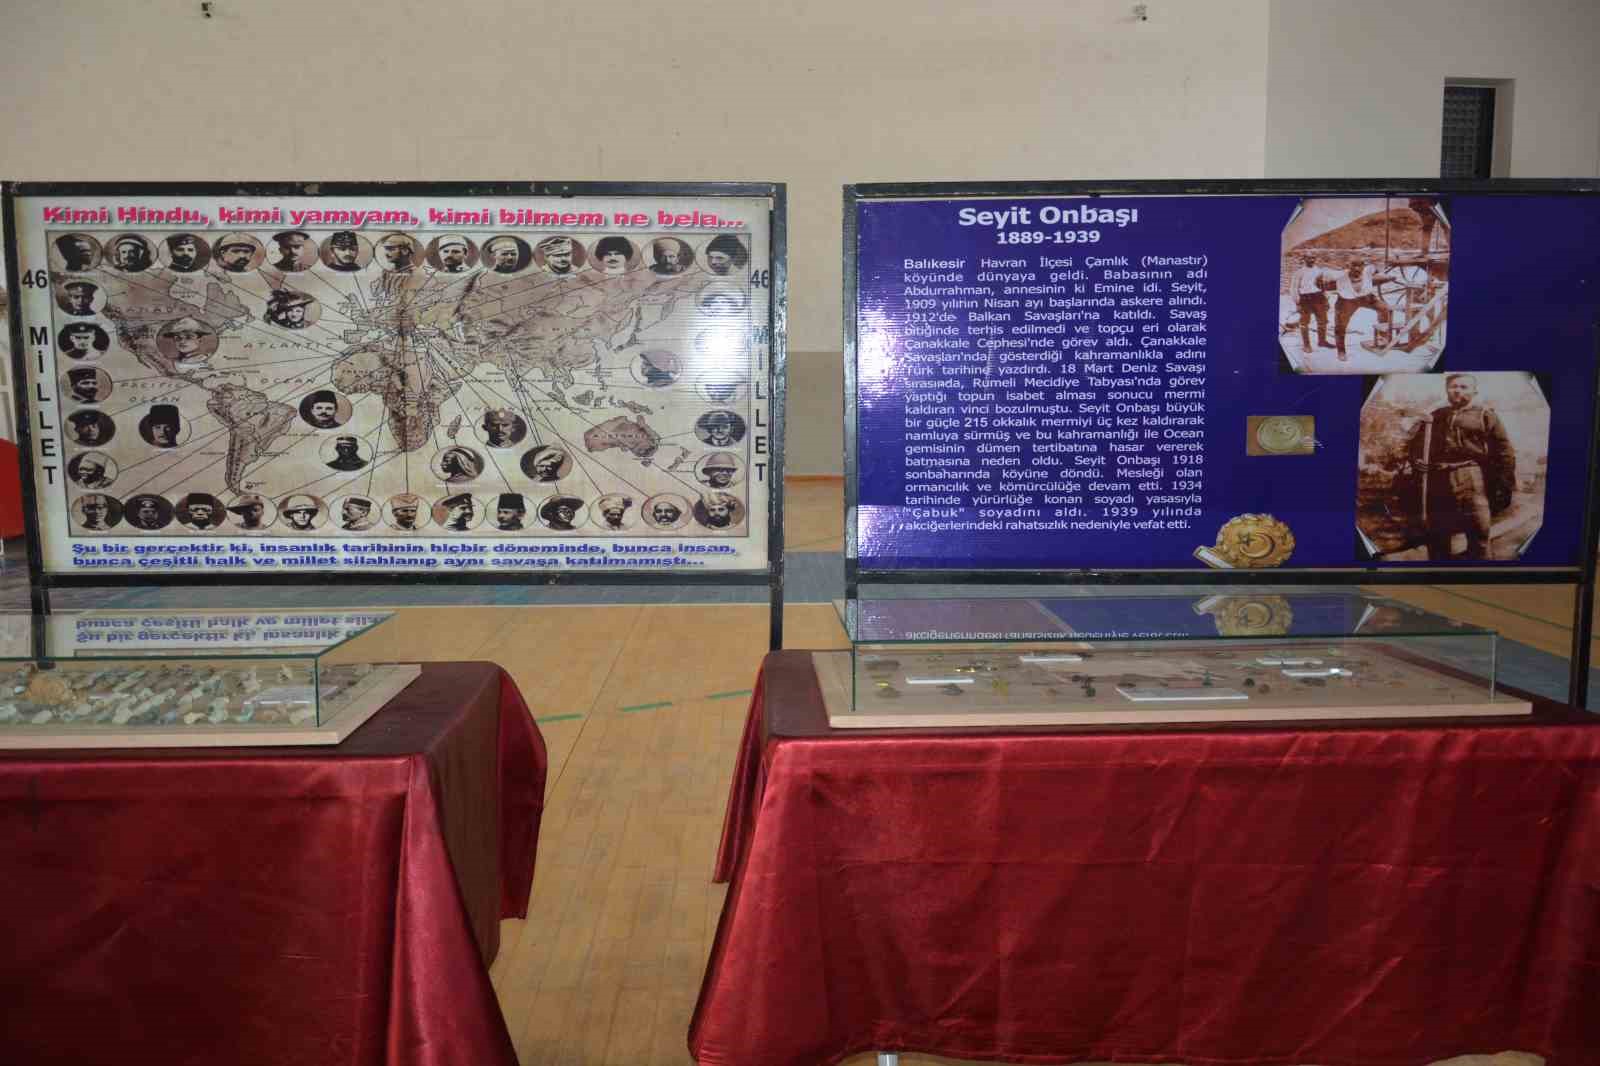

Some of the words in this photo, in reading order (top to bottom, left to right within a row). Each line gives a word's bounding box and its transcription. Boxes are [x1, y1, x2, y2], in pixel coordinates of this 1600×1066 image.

[43, 207, 110, 224] Kimi
[117, 207, 209, 226] Hindu,
[219, 208, 280, 224] kimi
[290, 208, 420, 228] yamyam,
[428, 208, 489, 224] kimi
[499, 208, 606, 225] bilmem
[614, 212, 648, 224] ne
[657, 208, 744, 226] bela...
[958, 206, 1031, 229] Seyit
[1039, 205, 1138, 228] Onbaşı
[997, 230, 1100, 244] 1889-1939
[904, 257, 966, 269] Balıkesir
[980, 256, 1027, 268] Havran
[1040, 254, 1073, 270] İlçesi
[1085, 255, 1129, 269] Çamlık
[1141, 254, 1208, 268] (Manastır)
[22, 270, 48, 289] 46
[904, 271, 964, 285] köyünde
[976, 270, 1036, 284] dünyaya
[1049, 269, 1089, 283] geldi.
[1104, 268, 1173, 279] Babasının
[1186, 267, 1208, 279] adı
[904, 284, 995, 297] Abdurrahman,
[1003, 283, 1066, 294] annesinin
[1094, 282, 1135, 293] Emine
[1143, 281, 1162, 293] idi.
[1170, 281, 1207, 295] Seyit,
[904, 298, 937, 309] 1909
[984, 297, 1020, 308] Nisan
[1024, 299, 1044, 310] ayı
[1049, 296, 1116, 310] başlarında
[1120, 295, 1164, 306] askere
[1168, 295, 1207, 306] alındı.
[968, 311, 1011, 322] Balkan
[1024, 310, 1100, 324] Savaşları'na
[1113, 309, 1156, 320] katıldı.
[1169, 308, 1208, 322] Savaş
[968, 324, 1004, 335] terhis
[1011, 323, 1066, 334] edilmedi
[1072, 325, 1090, 334] ve
[1097, 322, 1134, 336] topçu
[1142, 322, 1159, 333] eri
[1167, 321, 1207, 332] olarak
[904, 337, 970, 351] Çanakkale
[1061, 336, 1098, 349] görev
[1105, 335, 1133, 346] aldı.
[1140, 334, 1207, 348] Çanakkale
[998, 350, 1063, 364] gösterdiği
[1074, 349, 1164, 360] kahramanlıkla
[1175, 348, 1206, 359] adını
[998, 363, 1051, 376] yazdırdı.
[1061, 362, 1078, 373] 18
[1084, 362, 1114, 373] Mart
[1122, 361, 1158, 372] Deniz
[1165, 361, 1206, 375] Savaşı
[972, 376, 1016, 388] Rumeli
[1024, 376, 1080, 390] Mecidiye
[1168, 374, 1206, 388] görev
[904, 390, 947, 404] yaptığı
[958, 390, 995, 404] topun
[1006, 389, 1045, 400] isabet
[1055, 389, 1096, 400] alması
[1107, 391, 1153, 399] sonucu
[1164, 388, 1205, 399] mermi
[905, 403, 955, 415] kaldıran
[960, 403, 990, 414] vinci
[993, 402, 1073, 416] bozulmuştu.
[1078, 402, 1111, 416] Seyit
[1115, 401, 1160, 415] Onbaşı
[1166, 401, 1205, 415] büyük
[904, 417, 922, 428] bir
[926, 417, 960, 430] güçle
[964, 416, 991, 427] 215
[992, 416, 1037, 427] okkalık
[1041, 415, 1092, 429] mermiyi
[1096, 415, 1112, 429] üç
[1116, 415, 1138, 426] kez
[1142, 414, 1205, 426] kaldırarak
[905, 429, 959, 443] namluya
[963, 429, 1011, 443] sürmüş
[1015, 431, 1032, 440] ve
[1035, 428, 1052, 440] bu
[1057, 428, 1139, 442] kahramanlığı
[1144, 427, 1159, 439] ile
[1163, 427, 1204, 438] Ocean
[904, 442, 965, 456] gemisinin
[976, 442, 1021, 453] dümen
[1032, 441, 1098, 452] tertibatına
[1109, 440, 1145, 452] hasar
[1156, 440, 1204, 451] vererek
[905, 455, 971, 466] batmasına
[981, 454, 1021, 466] neden
[1031, 454, 1063, 465] oldu.
[1074, 454, 1106, 468] Seyit
[1116, 453, 1161, 467] Onbaşı
[1172, 453, 1204, 464] 1918
[904, 468, 990, 479] sonbaharında
[1002, 467, 1048, 481] köyüne
[1059, 467, 1104, 478] döndü.
[1116, 466, 1164, 480] Mesleği
[1176, 466, 1203, 477] olan
[904, 481, 970, 492] ormancılık
[976, 483, 992, 492] ve
[999, 480, 1081, 494] kömürcülüğe
[1088, 480, 1131, 491] devam
[1138, 479, 1163, 490] etti.
[1172, 479, 1202, 490] 1934
[905, 494, 961, 505] tarihinde
[972, 494, 1033, 507] yürürlüğe
[1044, 493, 1083, 504] konan
[1094, 493, 1134, 507] soyadı
[1146, 492, 1202, 506] yasasıyla
[904, 507, 967, 521] "Çabuk"
[978, 506, 1040, 520] soyadını
[1054, 506, 1087, 517] aldı.
[1103, 505, 1138, 517] 1939
[1152, 505, 1202, 519] yılında
[1005, 519, 1068, 530] rahatsızlık
[1070, 519, 1131, 532] nedeniyle
[1132, 518, 1165, 529] vefat
[1166, 518, 1191, 529] etti.
[73, 544, 97, 556] Şu
[99, 544, 129, 553] bir
[132, 544, 224, 556] gerçektir
[227, 544, 255, 555] ki,
[258, 544, 338, 553] insanlık
[341, 544, 430, 553] tarihinin
[430, 544, 488, 556] hiçbir
[489, 544, 608, 555] döneminde,
[610, 544, 672, 553] bunca
[677, 544, 736, 555] insan,
[73, 555, 134, 565] bunca
[138, 555, 199, 568] çeşitli
[202, 555, 246, 565] halk
[280, 555, 339, 565] millet
[341, 555, 438, 568] silahlanıp
[442, 557, 485, 568] aynı
[564, 555, 705, 568] katılmamıştı...
